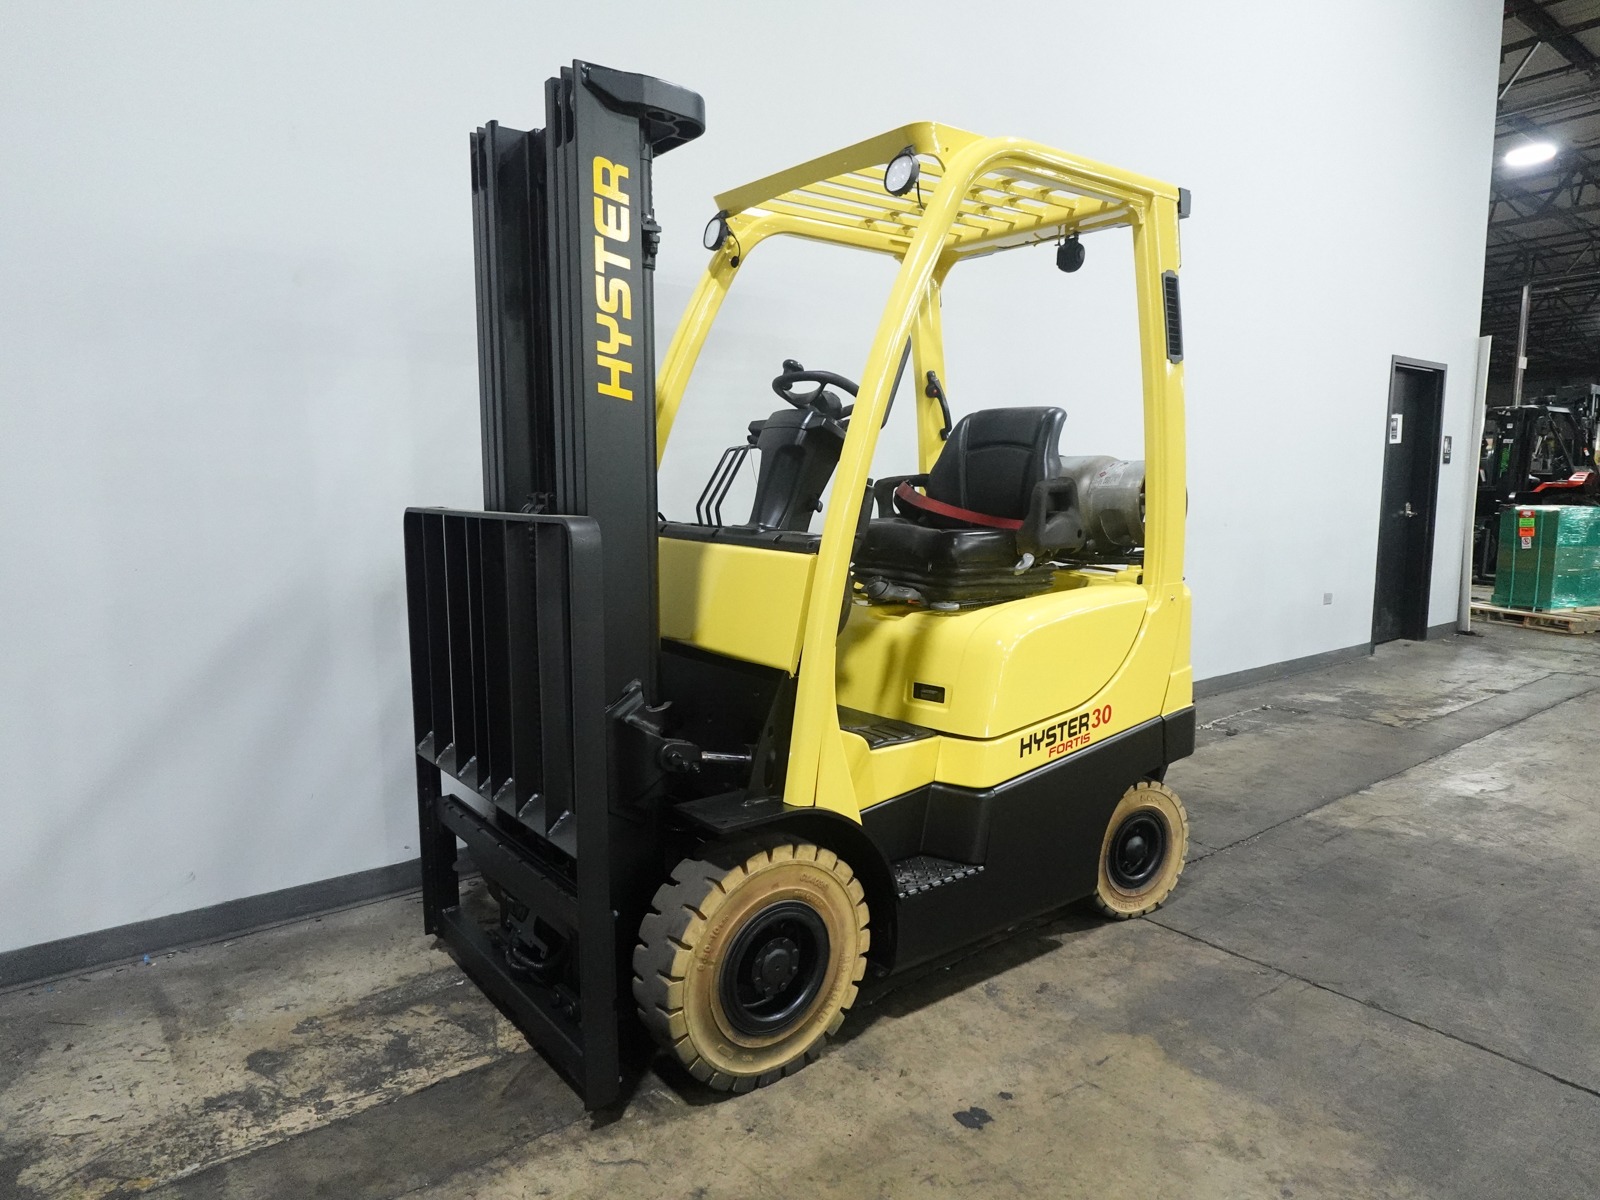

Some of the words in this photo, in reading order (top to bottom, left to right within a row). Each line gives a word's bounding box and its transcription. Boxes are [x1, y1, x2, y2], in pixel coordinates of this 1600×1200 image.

[593, 156, 633, 401] HYSTER
[1020, 712, 1090, 758] HYSTER
[1091, 704, 1112, 729] 30
[1048, 732, 1091, 758] FORTIS
